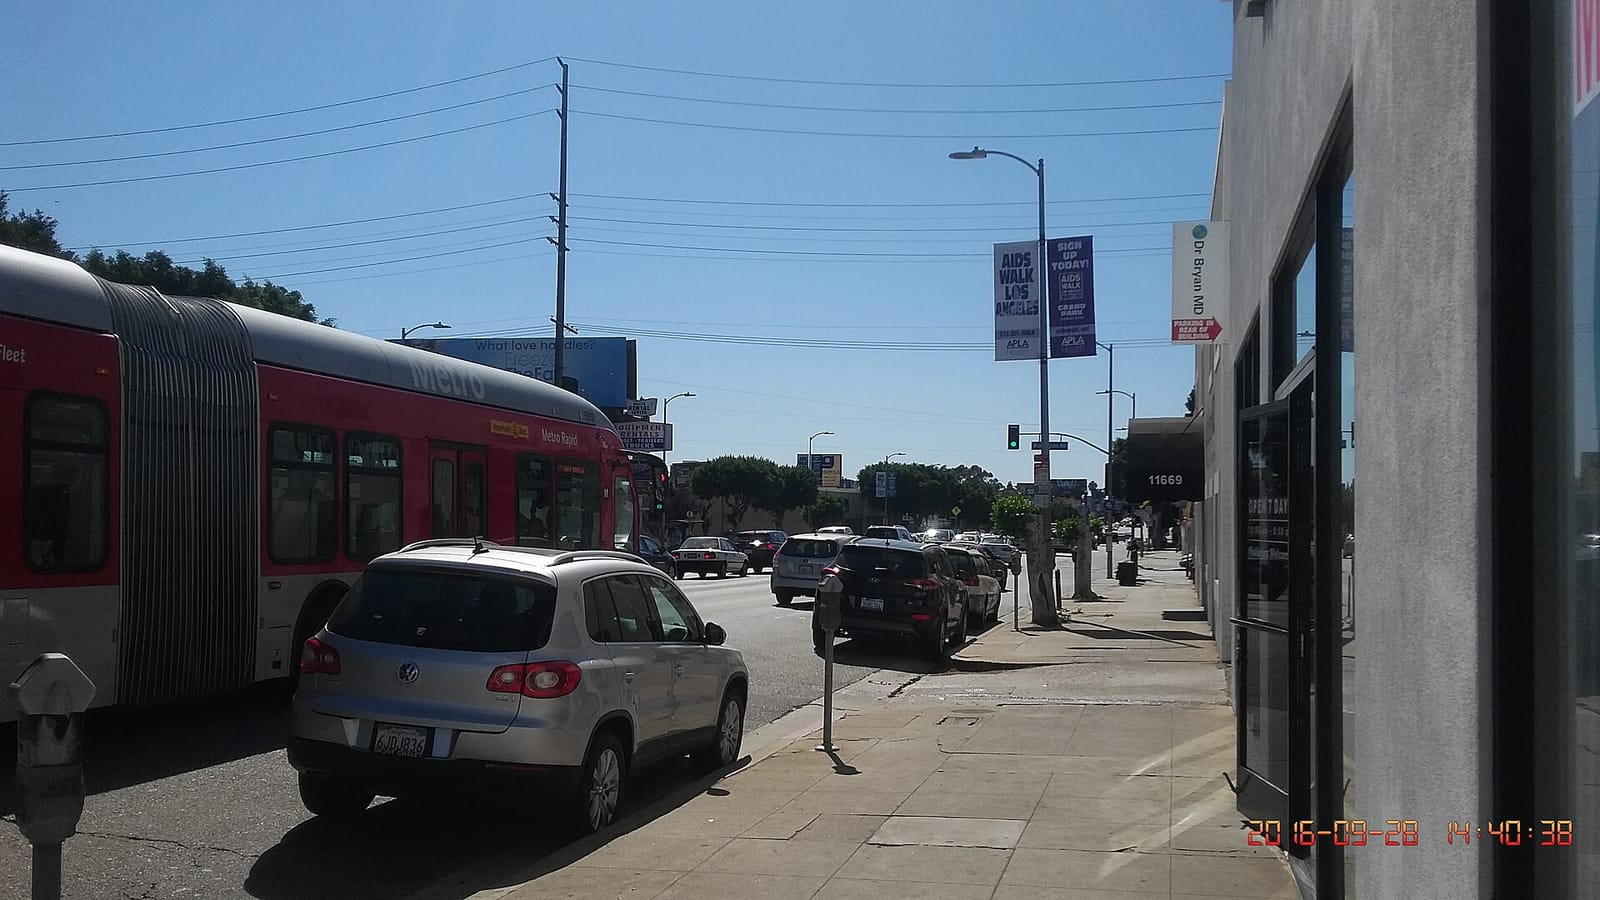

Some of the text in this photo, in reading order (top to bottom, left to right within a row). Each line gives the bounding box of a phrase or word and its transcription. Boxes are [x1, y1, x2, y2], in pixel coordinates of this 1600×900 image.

[1057, 241, 1082, 252] SIGN
[1001, 252, 1031, 269] AIDS
[1062, 251, 1077, 260] UP
[1051, 258, 1089, 271] TODAY!
[999, 268, 1034, 285] WALK
[1061, 273, 1081, 282] AIDS
[1192, 241, 1205, 315] Dr Bryan MD
[1061, 282, 1081, 290] WALK
[1005, 284, 1029, 301] LOS
[996, 300, 1039, 317] ANGELES
[1057, 303, 1086, 311] GRAND
[476, 339, 595, 351] What love hadles?
[1006, 339, 1029, 349] APLA
[1061, 336, 1085, 347] APLA
[408, 358, 486, 400] Metro
[541, 428, 561, 444] Metro
[561, 431, 578, 448] Rapid
[1148, 474, 1183, 485] 11669
[376, 735, 425, 753] 6JDJ836
